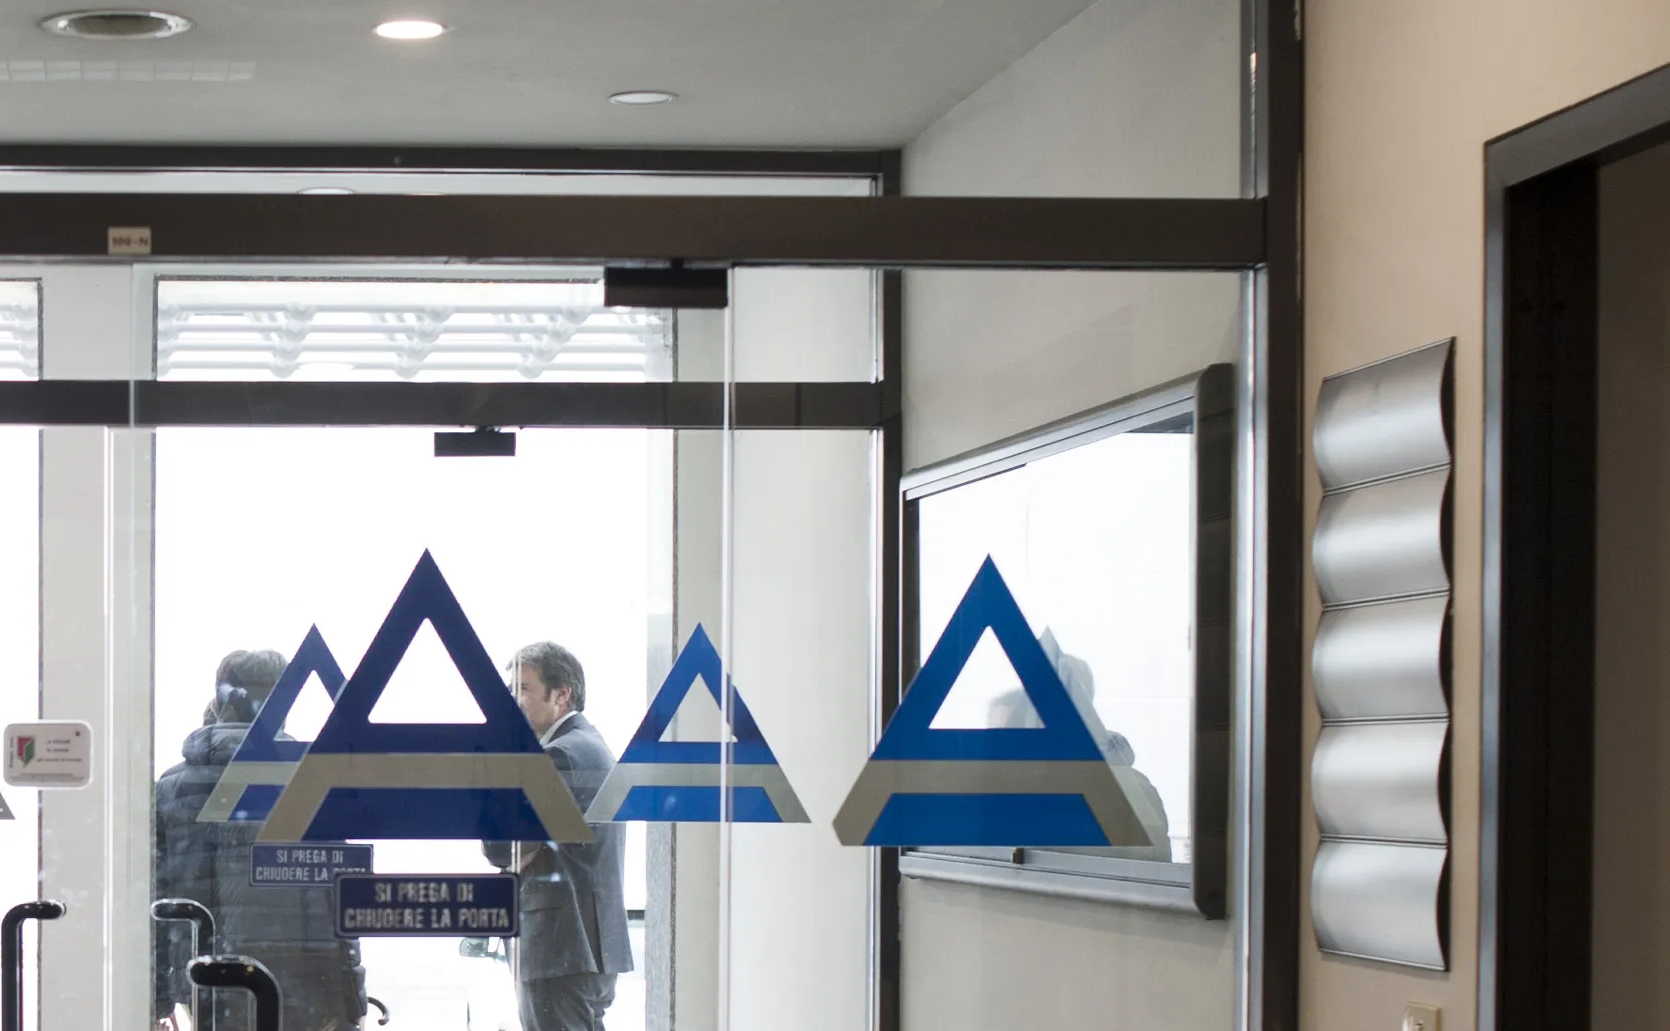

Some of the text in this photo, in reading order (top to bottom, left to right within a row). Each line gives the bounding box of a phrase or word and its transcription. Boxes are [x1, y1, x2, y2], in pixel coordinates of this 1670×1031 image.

[276, 850, 344, 864] SI PREGA DI
[255, 867, 310, 881] CHIUDERE
[314, 867, 328, 881] LA
[375, 882, 473, 903] SI PREGA DI
[344, 908, 509, 929] CHIUDERE LA PORTA
